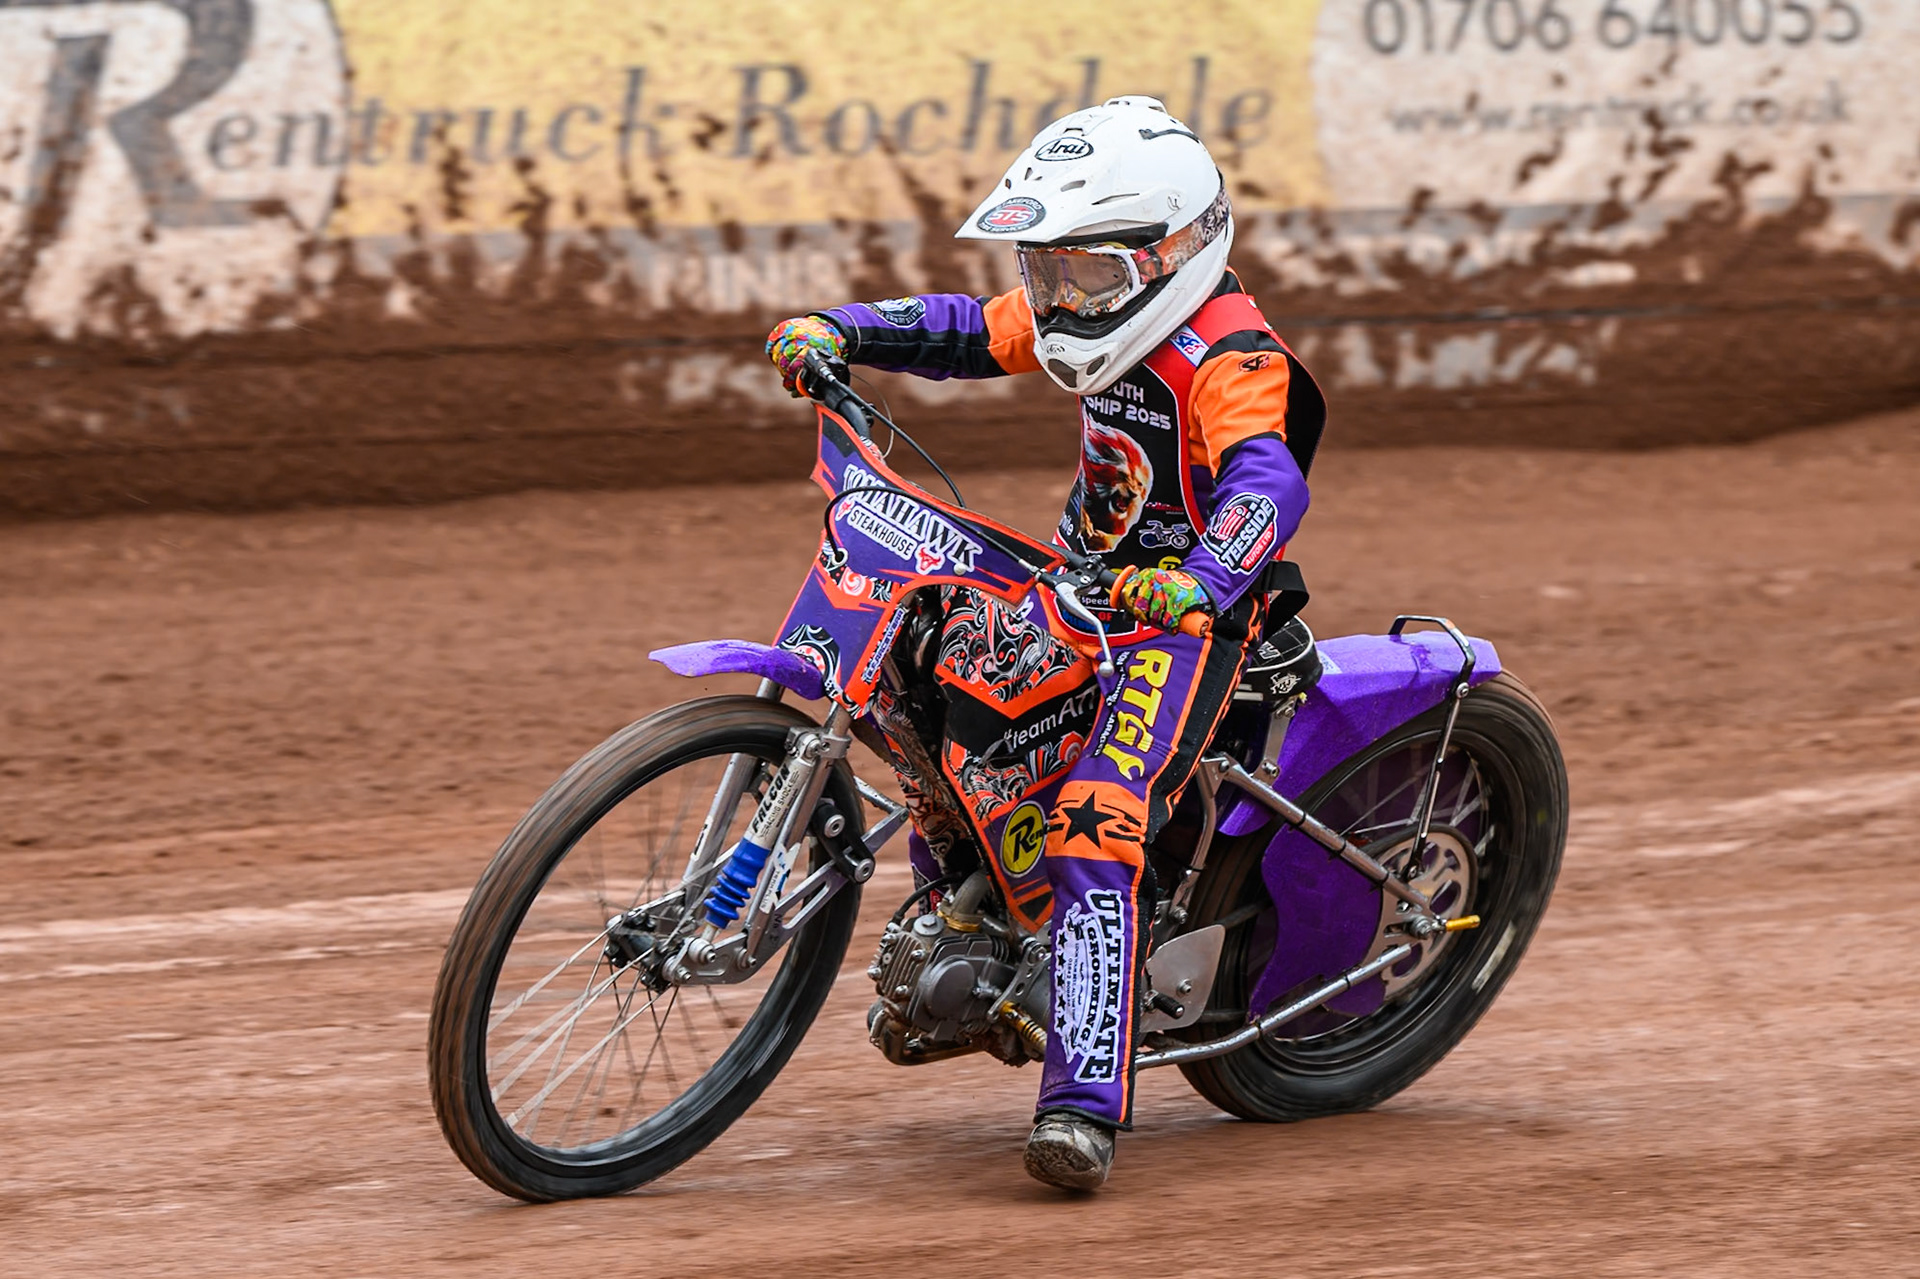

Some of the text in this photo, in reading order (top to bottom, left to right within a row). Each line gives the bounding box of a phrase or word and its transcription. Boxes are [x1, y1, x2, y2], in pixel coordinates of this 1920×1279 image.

[728, 56, 1272, 158] Rochdle
[1044, 139, 1088, 155] Arai
[988, 210, 1034, 221] STS
[1125, 404, 1171, 430] 2025
[844, 466, 980, 568] TOMAHAWK
[850, 509, 915, 556] STEAKHOUSE
[1221, 499, 1273, 567] TEESSIDE
[1245, 544, 1264, 566] AUTOS
[752, 763, 790, 834] FALCON
[1079, 926, 1102, 1042] GROOMING
[1079, 893, 1121, 1079] ULTIMATE
